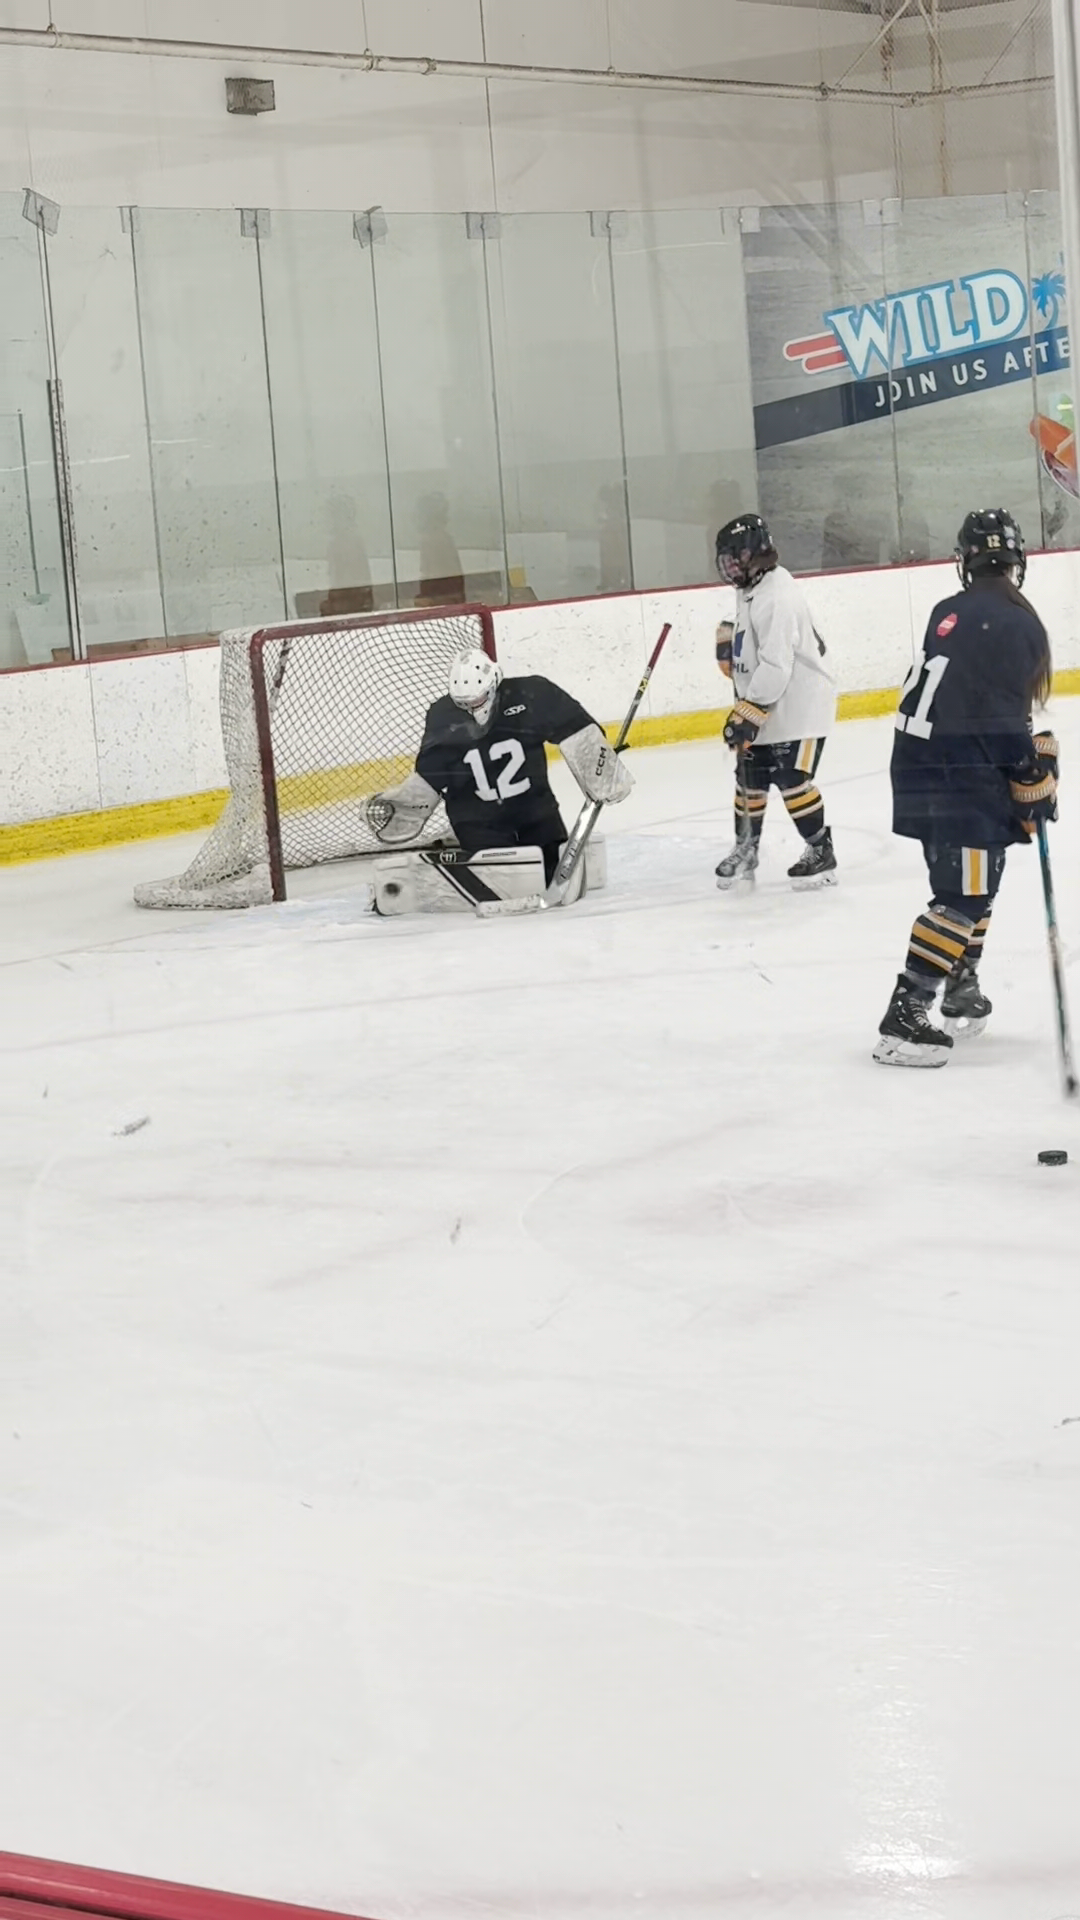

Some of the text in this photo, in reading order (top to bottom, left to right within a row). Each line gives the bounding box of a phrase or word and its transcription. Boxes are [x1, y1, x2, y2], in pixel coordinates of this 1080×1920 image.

[823, 268, 1029, 380] WILD
[875, 371, 937, 407] JOIN
[952, 359, 988, 385] US
[463, 738, 531, 801] 12
[595, 746, 607, 776] CCM
